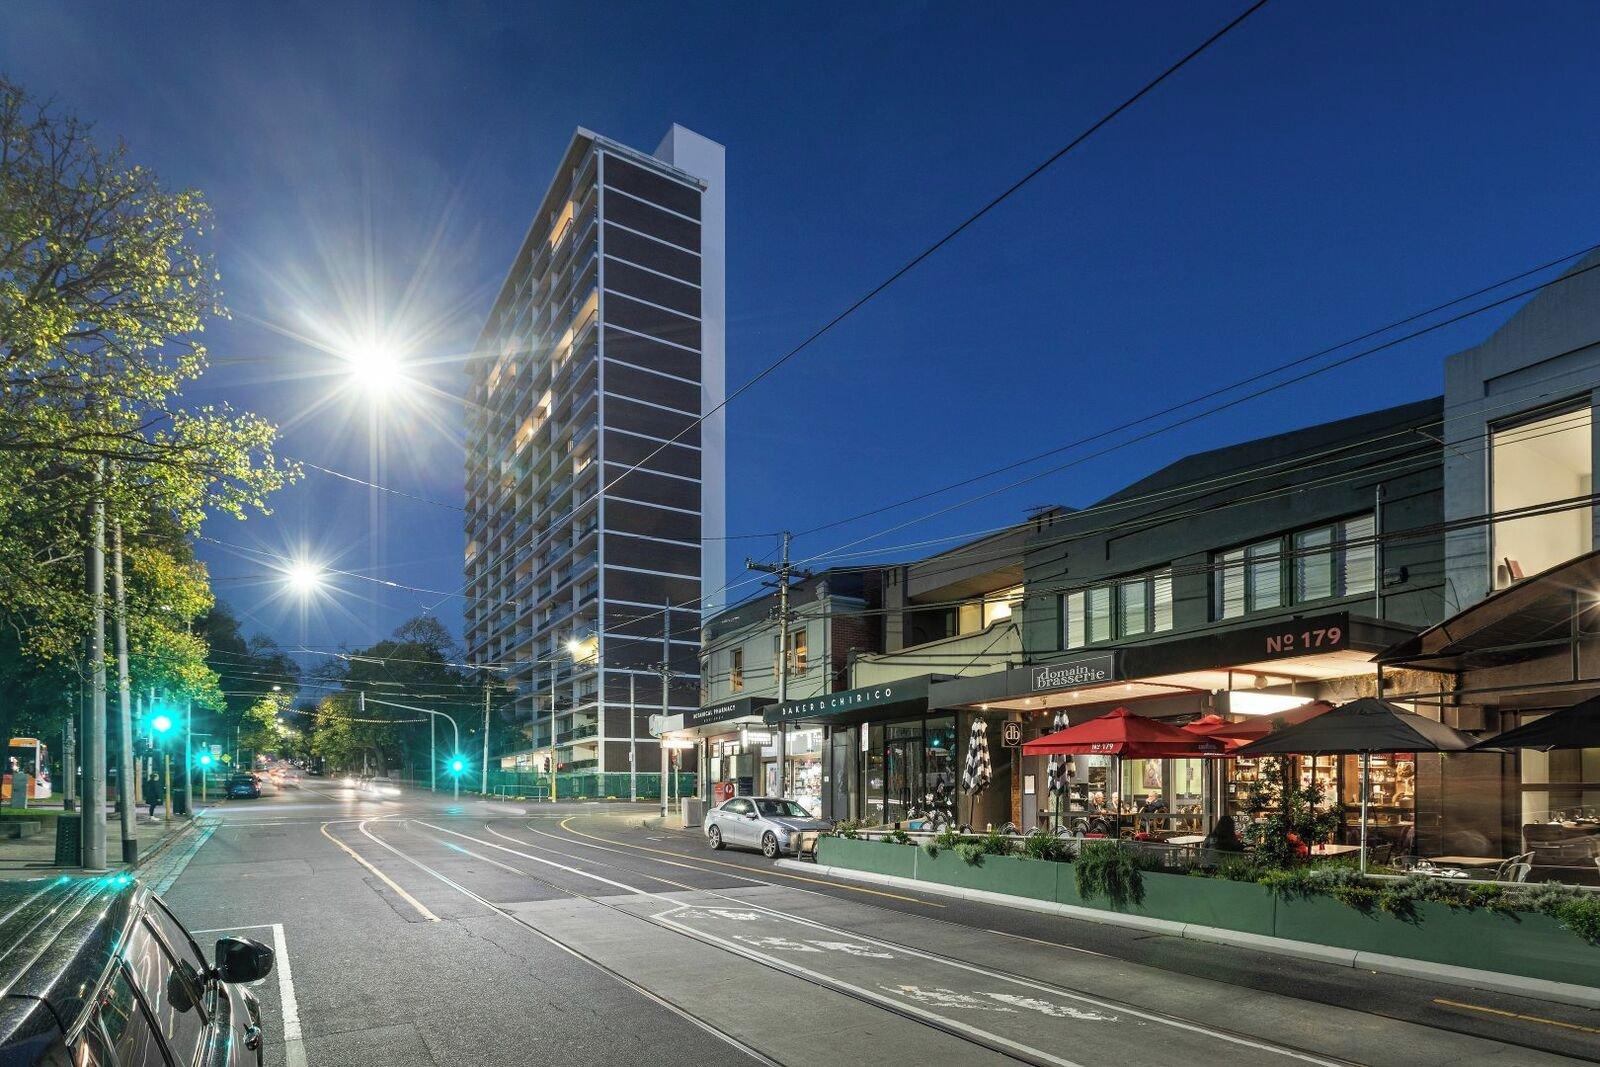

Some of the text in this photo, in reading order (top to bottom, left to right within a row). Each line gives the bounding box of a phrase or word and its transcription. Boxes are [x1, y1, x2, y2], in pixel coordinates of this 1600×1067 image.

[1301, 627, 1341, 648] 179
[1037, 668, 1105, 689] brasserie
[1040, 665, 1089, 681] domain
[782, 703, 815, 716] BAKER
[831, 688, 892, 707] CHIRICO
